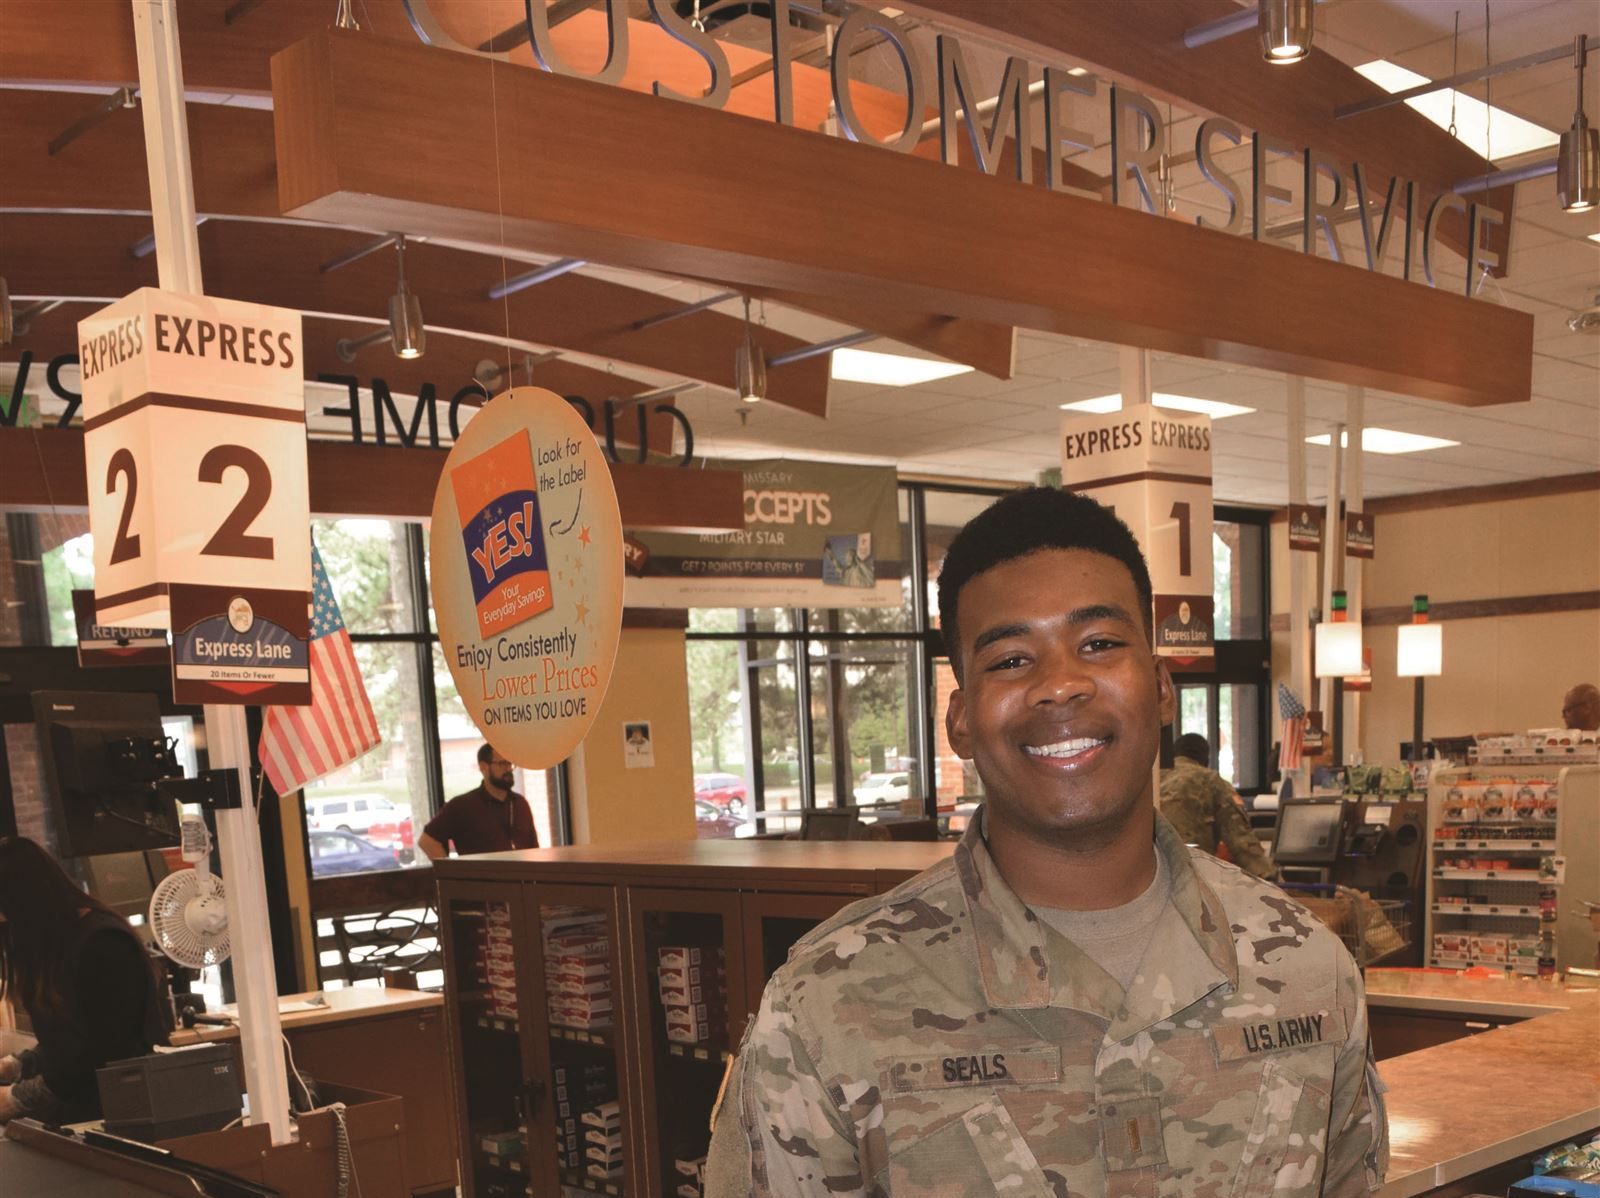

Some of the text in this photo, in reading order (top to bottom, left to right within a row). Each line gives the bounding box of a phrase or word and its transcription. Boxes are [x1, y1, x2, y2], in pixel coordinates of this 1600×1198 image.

[1194, 117, 1505, 298] SERVICE
[83, 315, 144, 380] EXPRESS
[154, 313, 295, 369] EXPRESS
[538, 438, 582, 466] Look for
[1066, 421, 1142, 460] EXPRESS
[1151, 421, 1210, 452] EXPRESS
[540, 460, 586, 492] the Label
[106, 447, 141, 566] 2
[198, 444, 274, 560] 2
[744, 491, 832, 525] CCEPTS
[472, 501, 534, 583] YES!
[756, 531, 785, 545] STAR
[1169, 501, 1191, 577] 1
[483, 585, 545, 625] Everyday Savings
[501, 583, 520, 601] Your
[195, 638, 291, 661] Express Lane
[457, 626, 577, 672] Enjoy Consistently
[1164, 628, 1208, 647] Express Lane
[210, 671, 275, 680] 20 Items Or Fewer
[480, 656, 598, 701] Lower Prices
[484, 698, 587, 725] ON ITEMS YOU LOVE
[1242, 1014, 1324, 1053] U.S. ARMY
[942, 1054, 1008, 1083] SEALS
